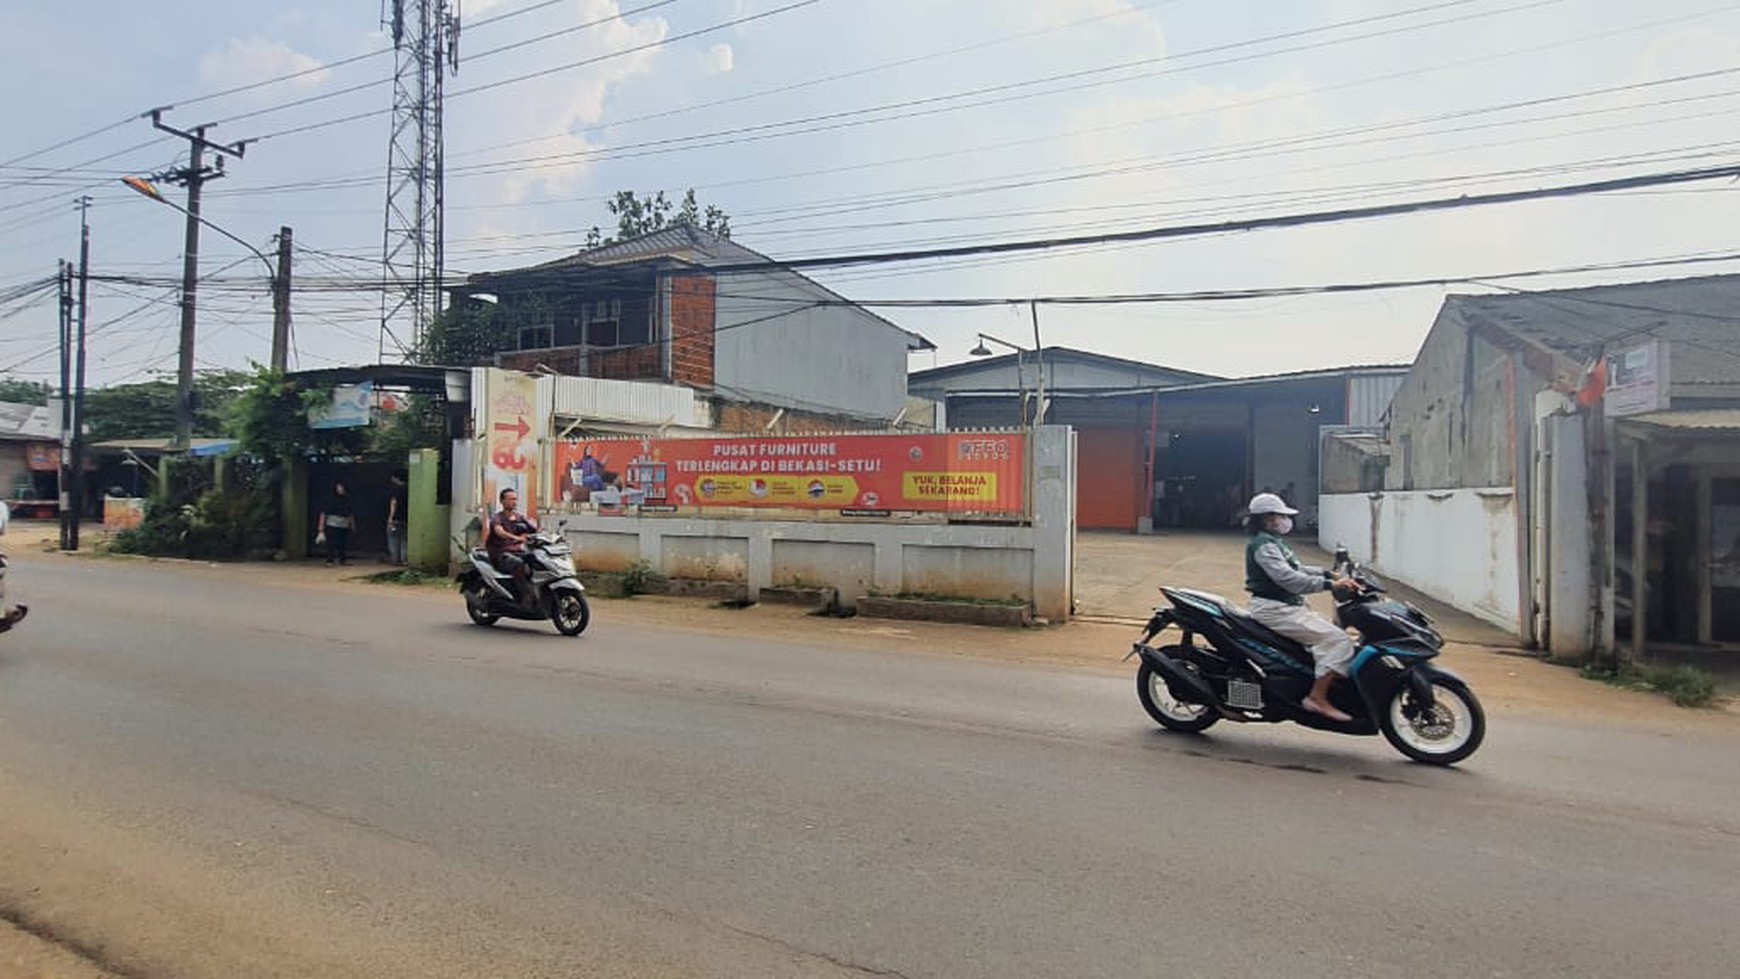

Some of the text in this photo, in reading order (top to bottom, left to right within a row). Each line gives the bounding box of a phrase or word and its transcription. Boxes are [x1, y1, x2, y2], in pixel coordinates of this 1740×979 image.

[713, 443, 837, 457] PUSAT FURNITURE
[676, 459, 881, 472] TERLENGKAP DI BEKASI-SETU!
[913, 475, 987, 486] YUK, BELANJA
[919, 485, 980, 495] SEKARANG!
